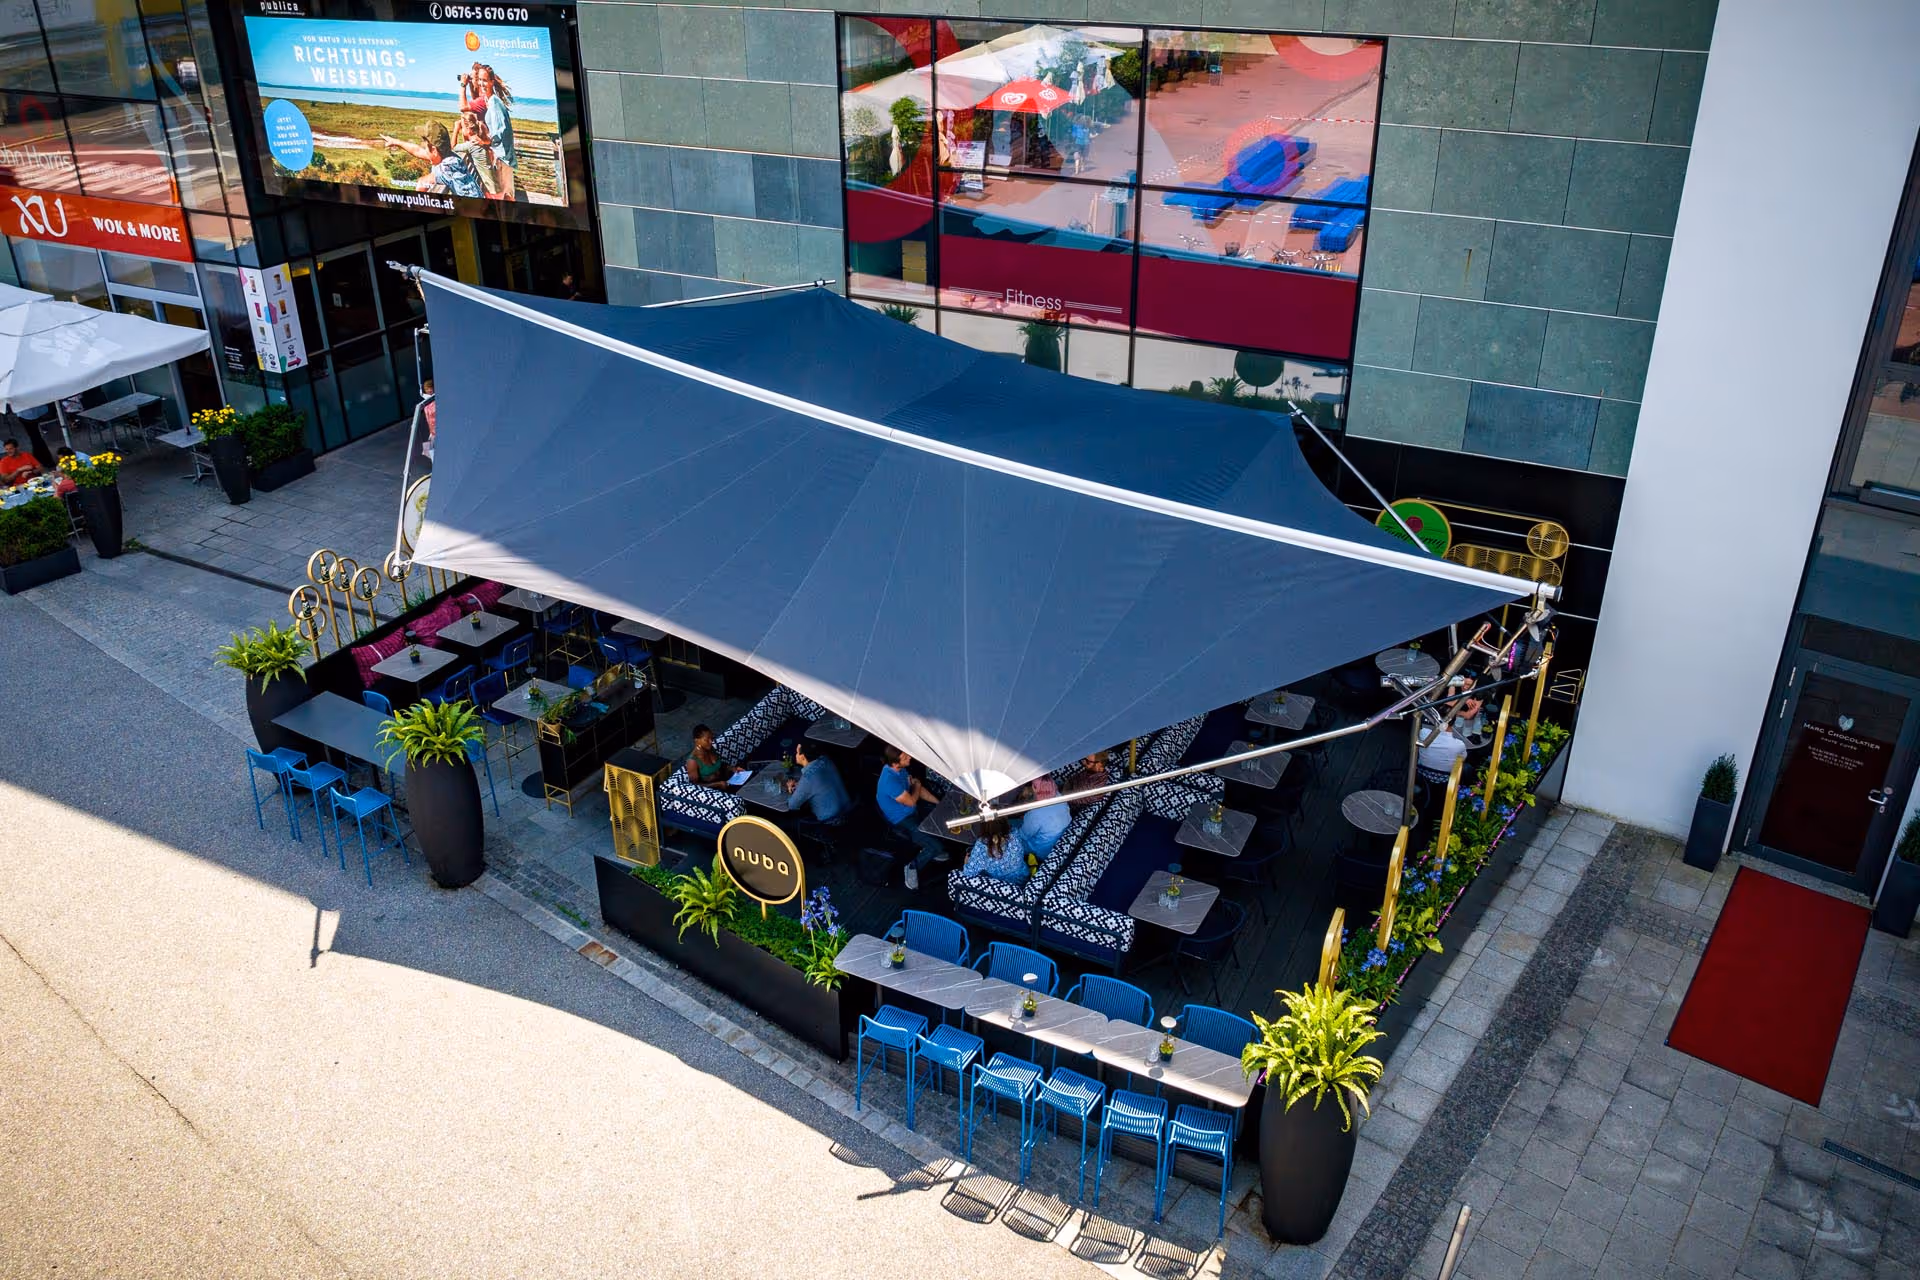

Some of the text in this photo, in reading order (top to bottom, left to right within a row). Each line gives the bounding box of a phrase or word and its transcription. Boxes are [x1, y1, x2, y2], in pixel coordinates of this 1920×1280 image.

[260, 1, 299, 11] publica
[445, 6, 529, 21] 0676-5 670 670
[482, 36, 539, 50] burgenland
[294, 45, 416, 67] RICHTUNGS-
[311, 66, 405, 88] WEISEND.
[0, 142, 25, 166] ohn
[377, 192, 455, 209] www.publica.at
[92, 216, 182, 243] WOK & MORE
[1006, 288, 1062, 311] Fitness
[733, 846, 789, 876] nuba
